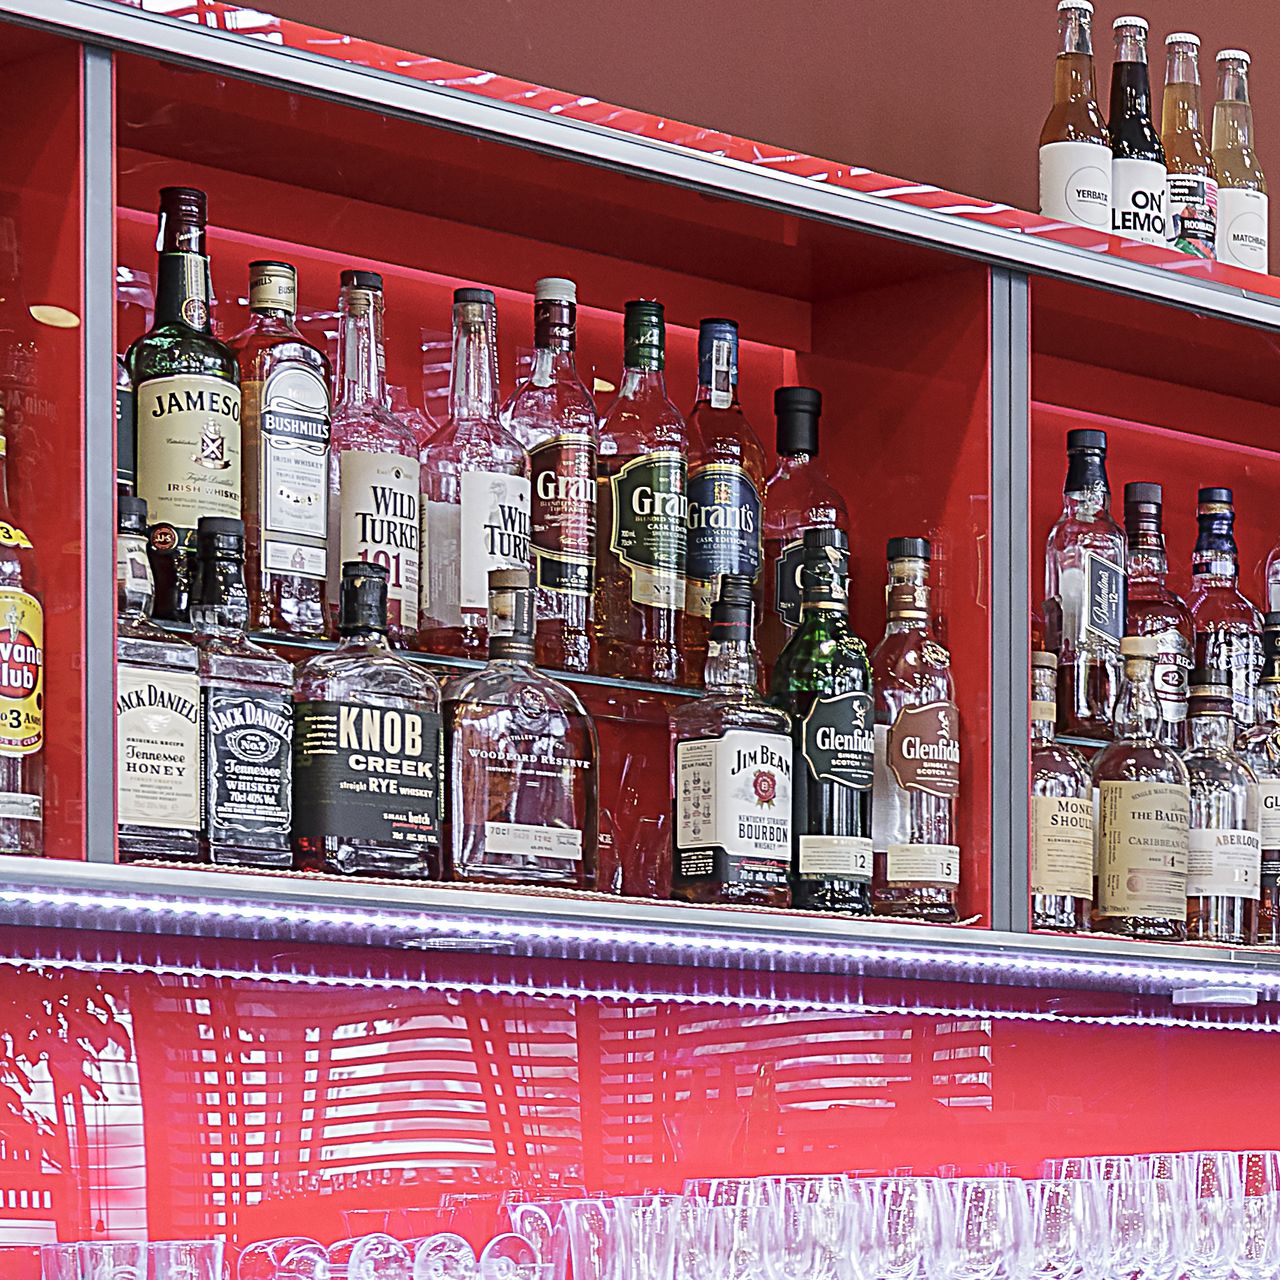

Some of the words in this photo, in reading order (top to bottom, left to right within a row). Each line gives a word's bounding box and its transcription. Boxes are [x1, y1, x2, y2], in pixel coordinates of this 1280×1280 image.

[265, 415, 329, 438] BUSHMILLS
[168, 484, 200, 493] IRISH
[372, 485, 416, 521] WILD
[687, 502, 753, 533] Grant's
[1168, 672, 1180, 684] 12
[117, 689, 144, 716] JACK
[9, 709, 21, 729] 3
[210, 707, 243, 734] JACK
[340, 706, 422, 756] KNOB
[126, 745, 186, 764] Tennessee
[468, 749, 538, 763] WOODFORD
[541, 754, 591, 769] RESERVE
[731, 749, 758, 775] JIM
[126, 763, 186, 777] HONEY
[224, 759, 282, 777] Tennessee
[349, 755, 433, 778] CREEK
[225, 779, 281, 793] WHISKEY
[369, 778, 397, 794] RYE
[1131, 811, 1152, 820] THE
[739, 824, 788, 842] BOURBON
[1128, 836, 1180, 849] CARIBBEAN
[853, 855, 866, 869] 12
[940, 862, 952, 876] 15
[1162, 855, 1175, 868] 14
